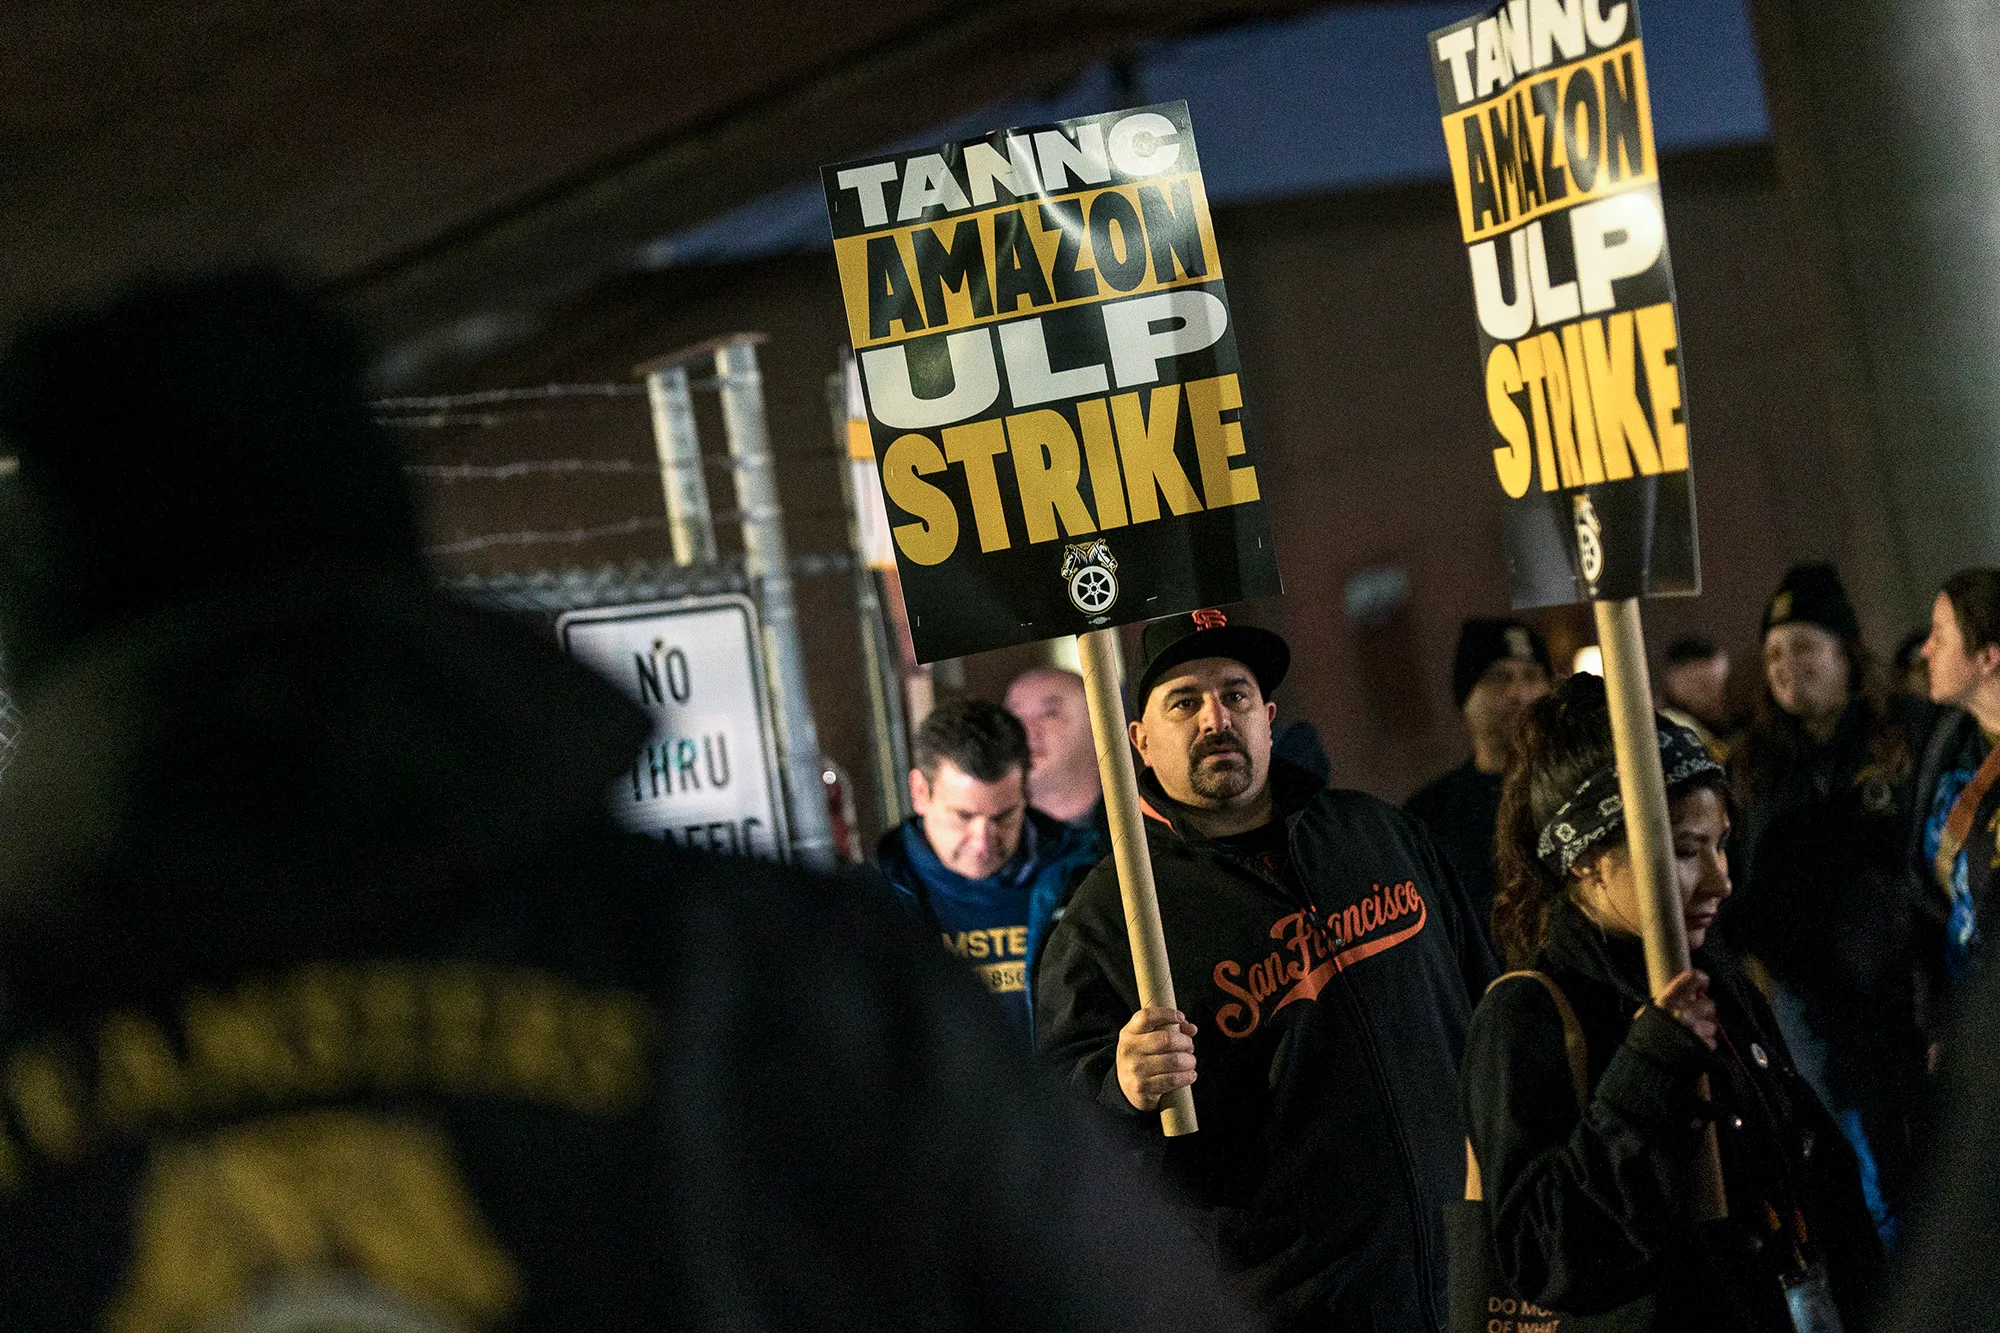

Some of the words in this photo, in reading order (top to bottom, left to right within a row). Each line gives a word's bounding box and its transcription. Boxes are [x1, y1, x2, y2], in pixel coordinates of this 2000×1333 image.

[1437, 0, 1630, 104] TANNC
[836, 113, 1181, 228] TANNC
[1463, 51, 1644, 234] AMAZON
[865, 181, 1209, 340] AMAZON
[1468, 191, 1665, 341] ULP
[861, 290, 1228, 429] ULP
[1485, 302, 1690, 499] STRIKE
[883, 373, 1261, 566] STRIKE
[634, 646, 691, 705] NO
[1213, 951, 1291, 1039] San
[1269, 879, 1426, 981] Francisco
[1488, 1296, 1517, 1315] DO
